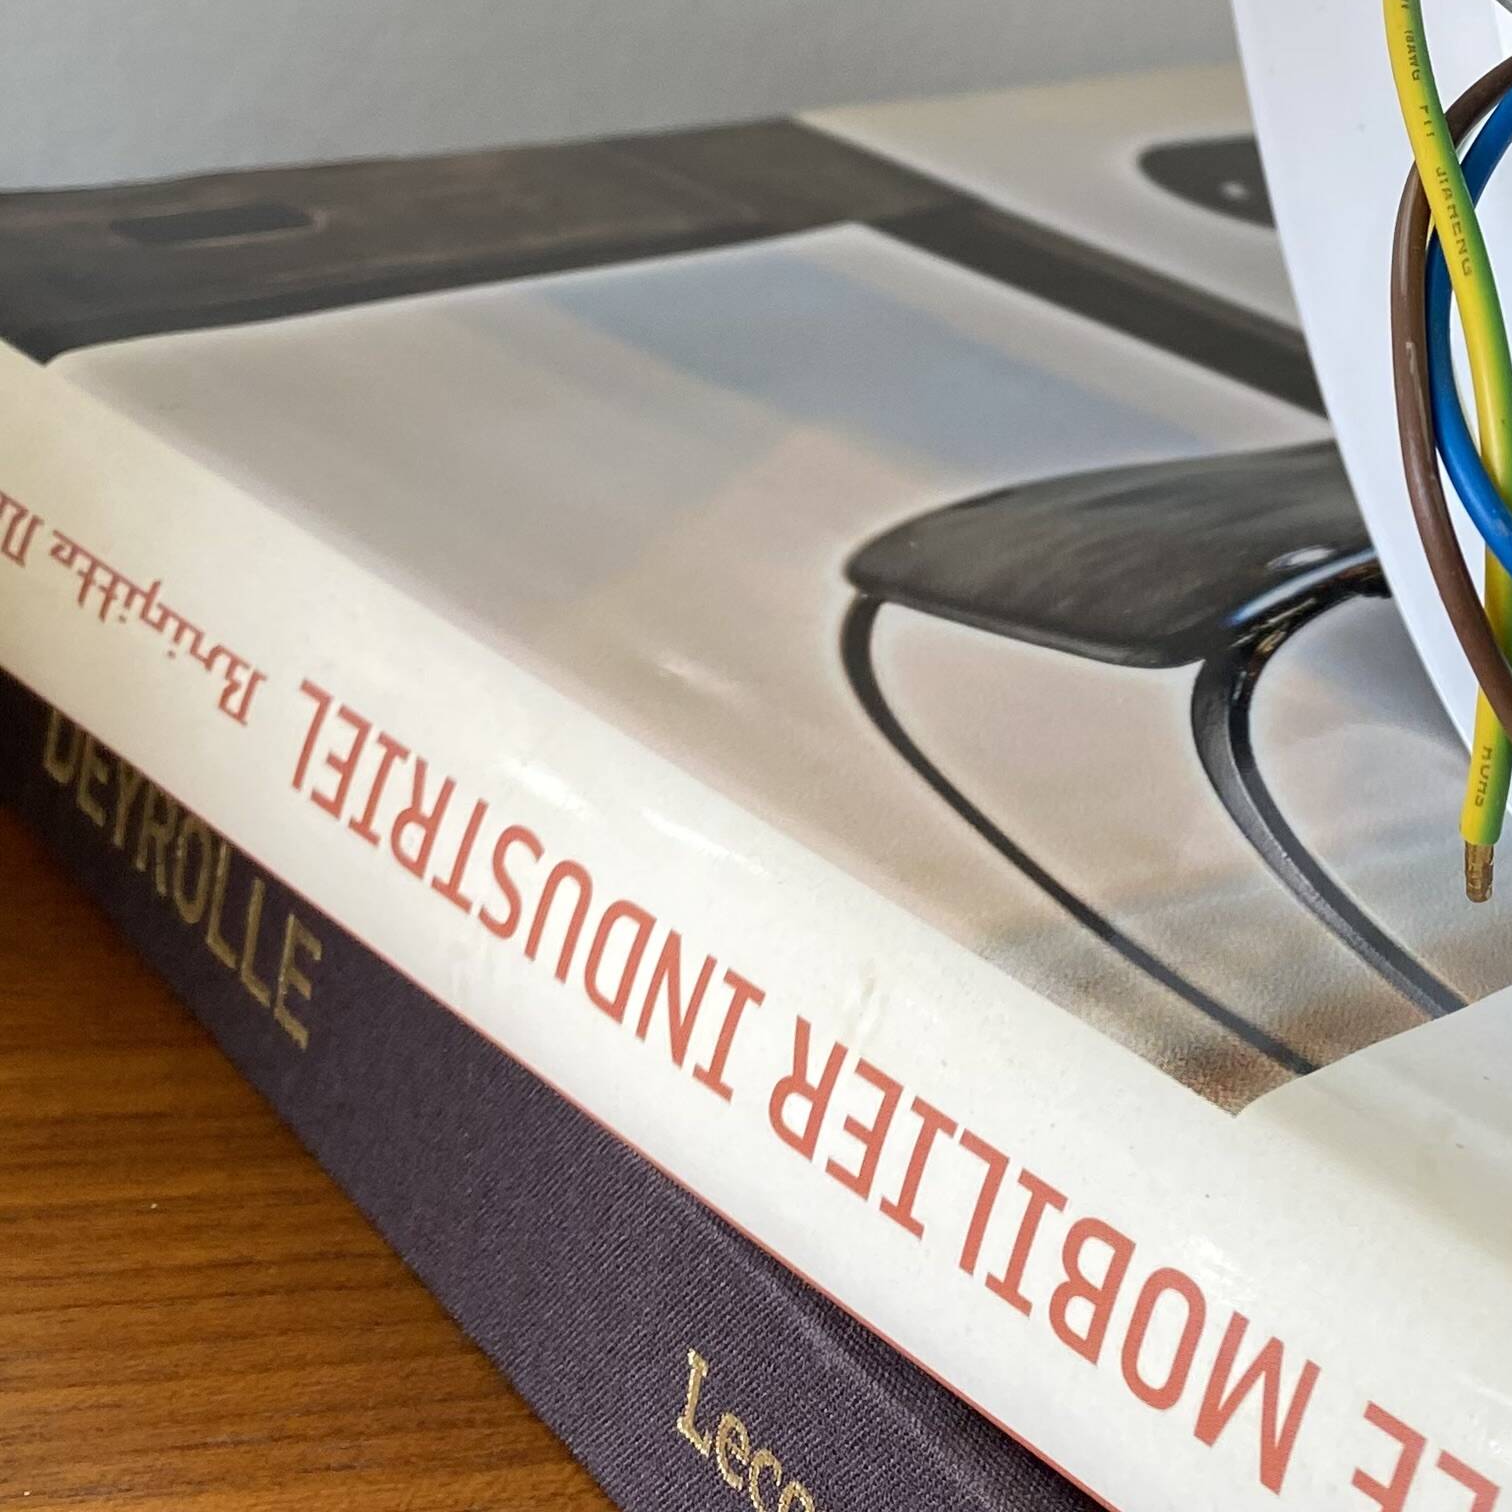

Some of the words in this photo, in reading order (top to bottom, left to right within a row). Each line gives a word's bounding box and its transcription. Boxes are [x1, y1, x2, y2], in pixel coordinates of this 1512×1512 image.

[49, 529, 268, 727] Brigitte
[291, 678, 767, 1103] INDUSTRIEL
[767, 1014, 1322, 1495] MOBILIER
